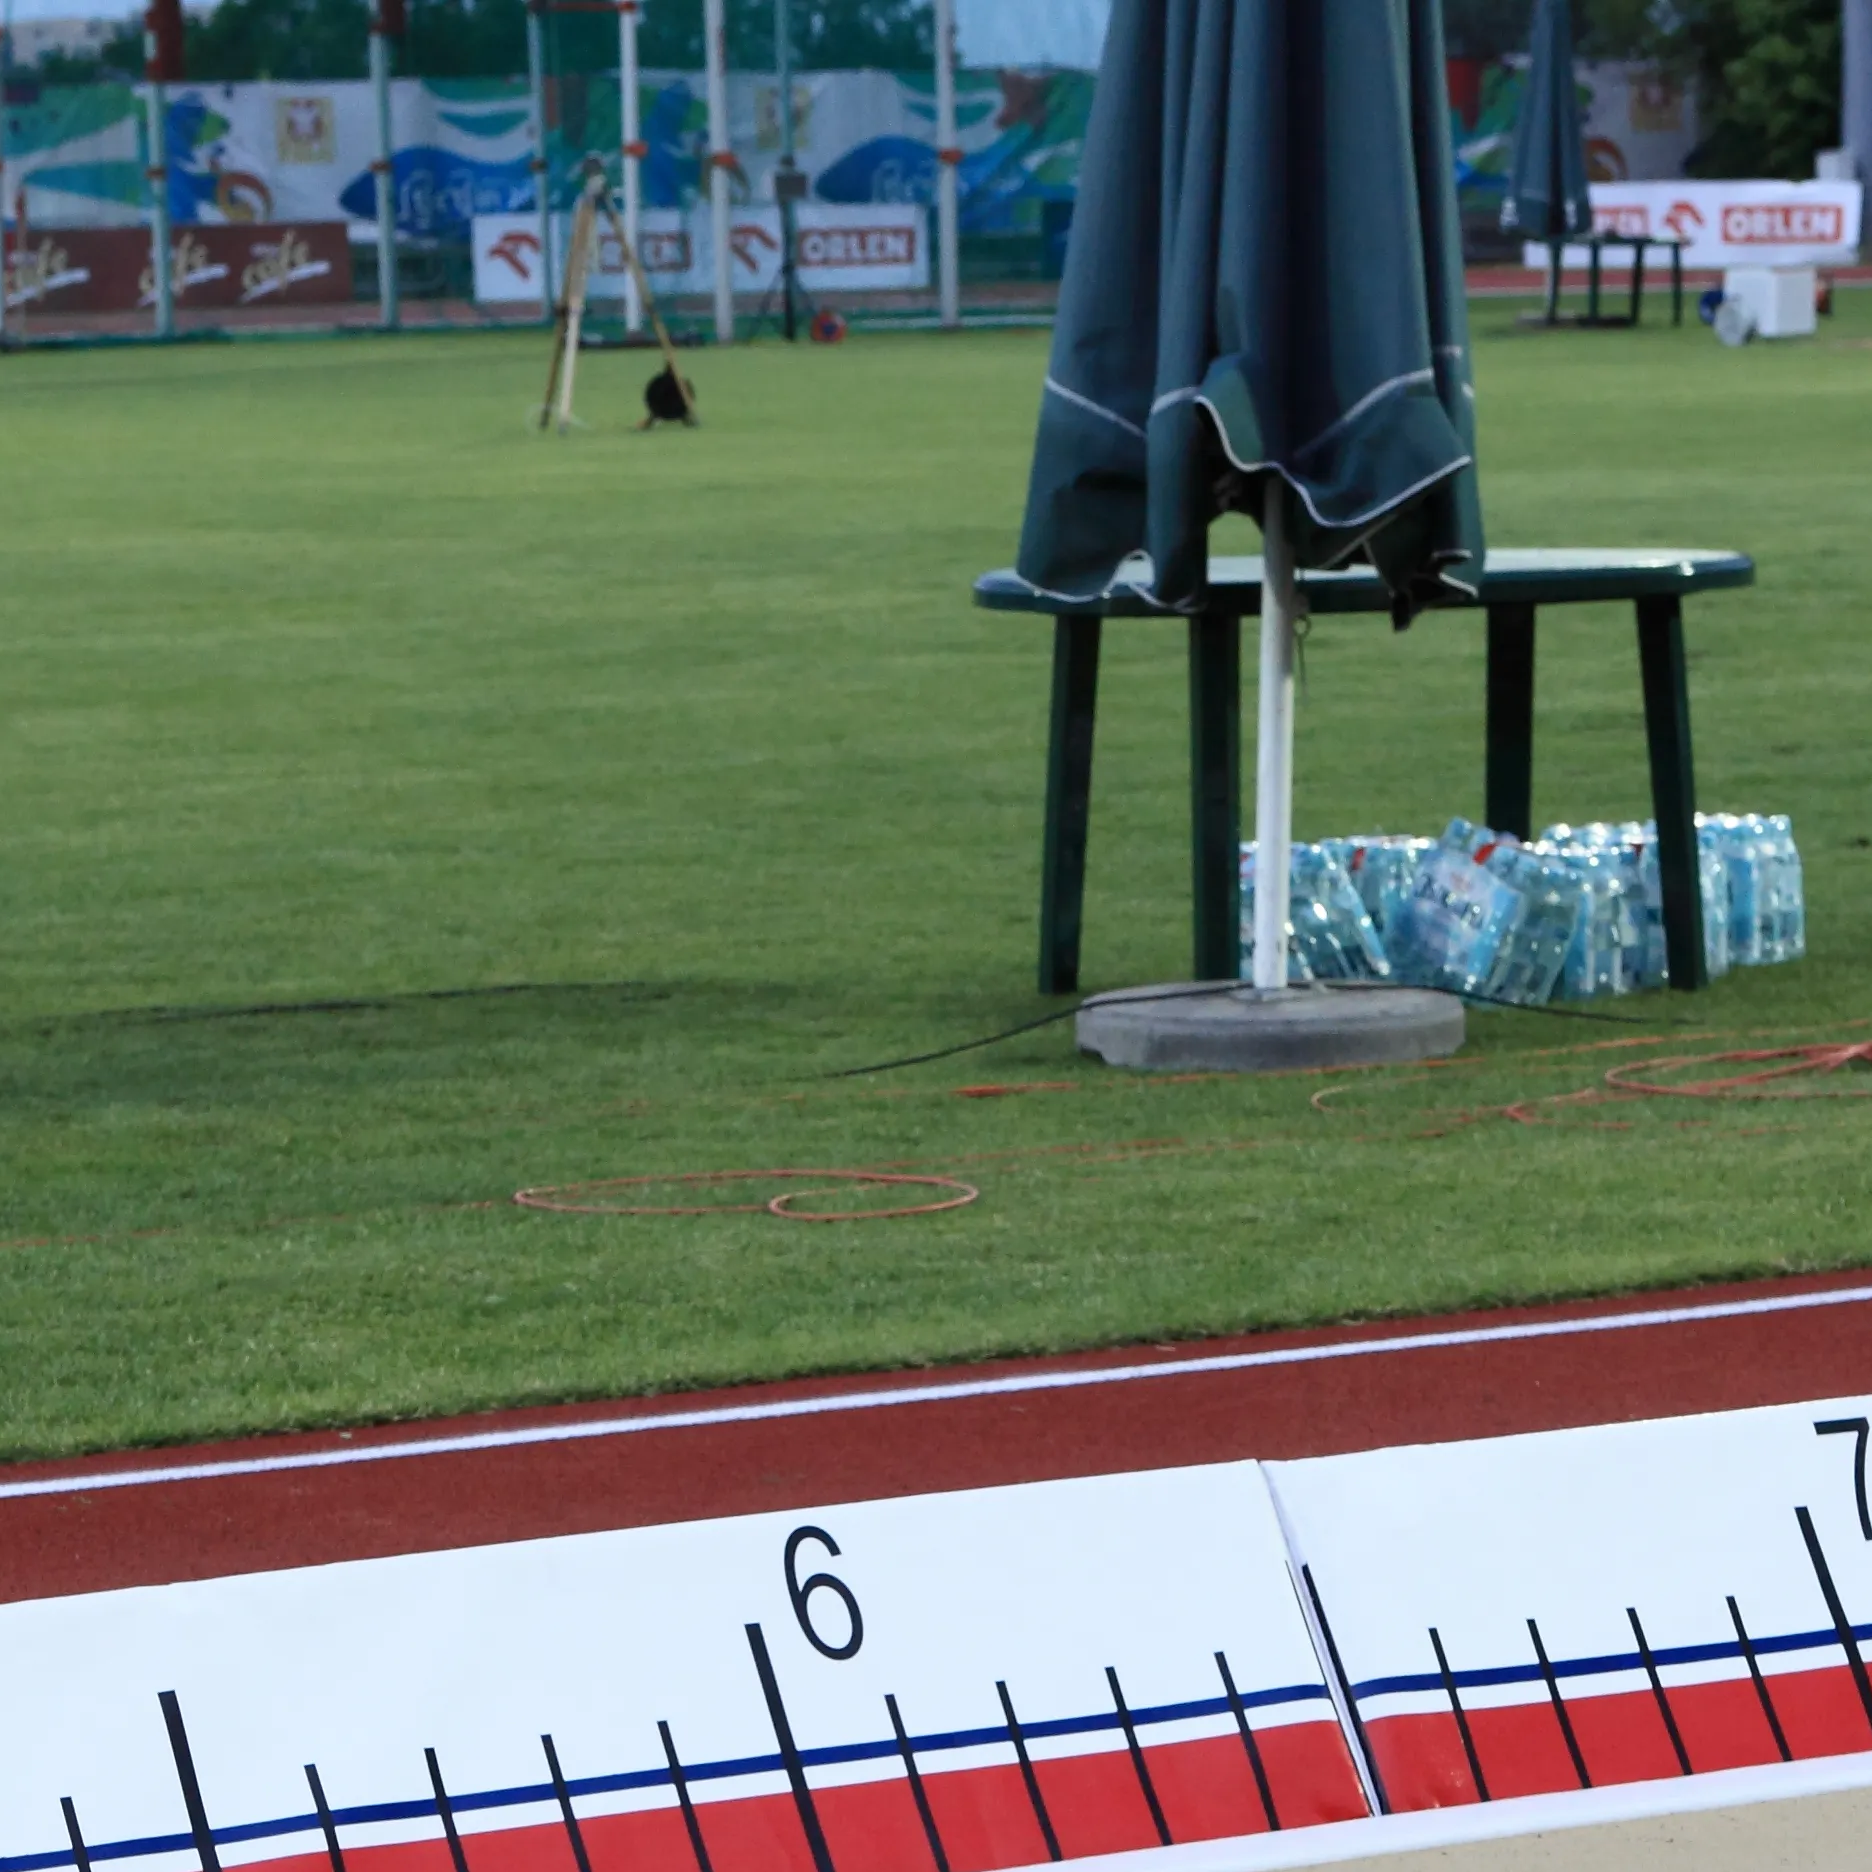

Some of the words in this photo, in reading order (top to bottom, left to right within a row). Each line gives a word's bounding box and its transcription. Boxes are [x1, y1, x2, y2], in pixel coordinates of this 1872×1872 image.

[1726, 208, 1838, 240] ORLEN
[804, 231, 908, 261] ORLEN
[783, 1525, 864, 1661] 6
